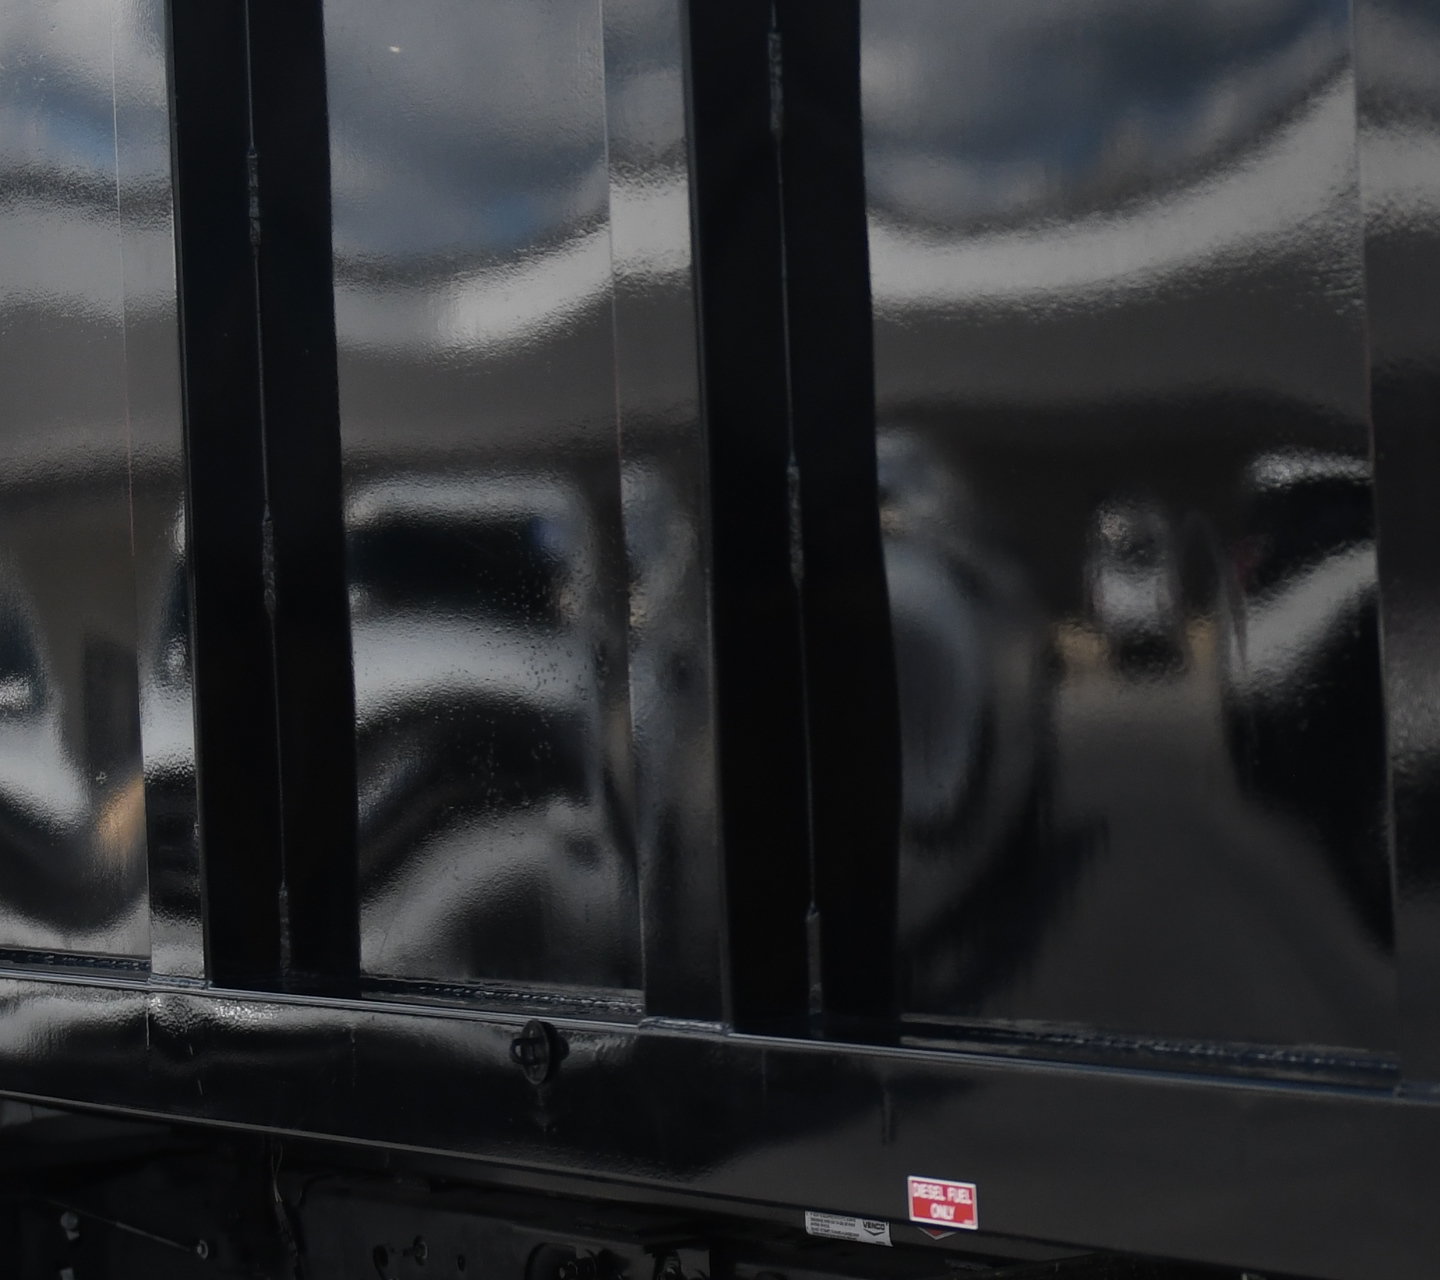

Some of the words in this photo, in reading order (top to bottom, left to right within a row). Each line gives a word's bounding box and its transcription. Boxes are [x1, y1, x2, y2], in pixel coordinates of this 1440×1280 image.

[912, 1182, 946, 1201] DIESEL
[947, 1187, 973, 1205] FUEL
[930, 1203, 955, 1220] ONLY
